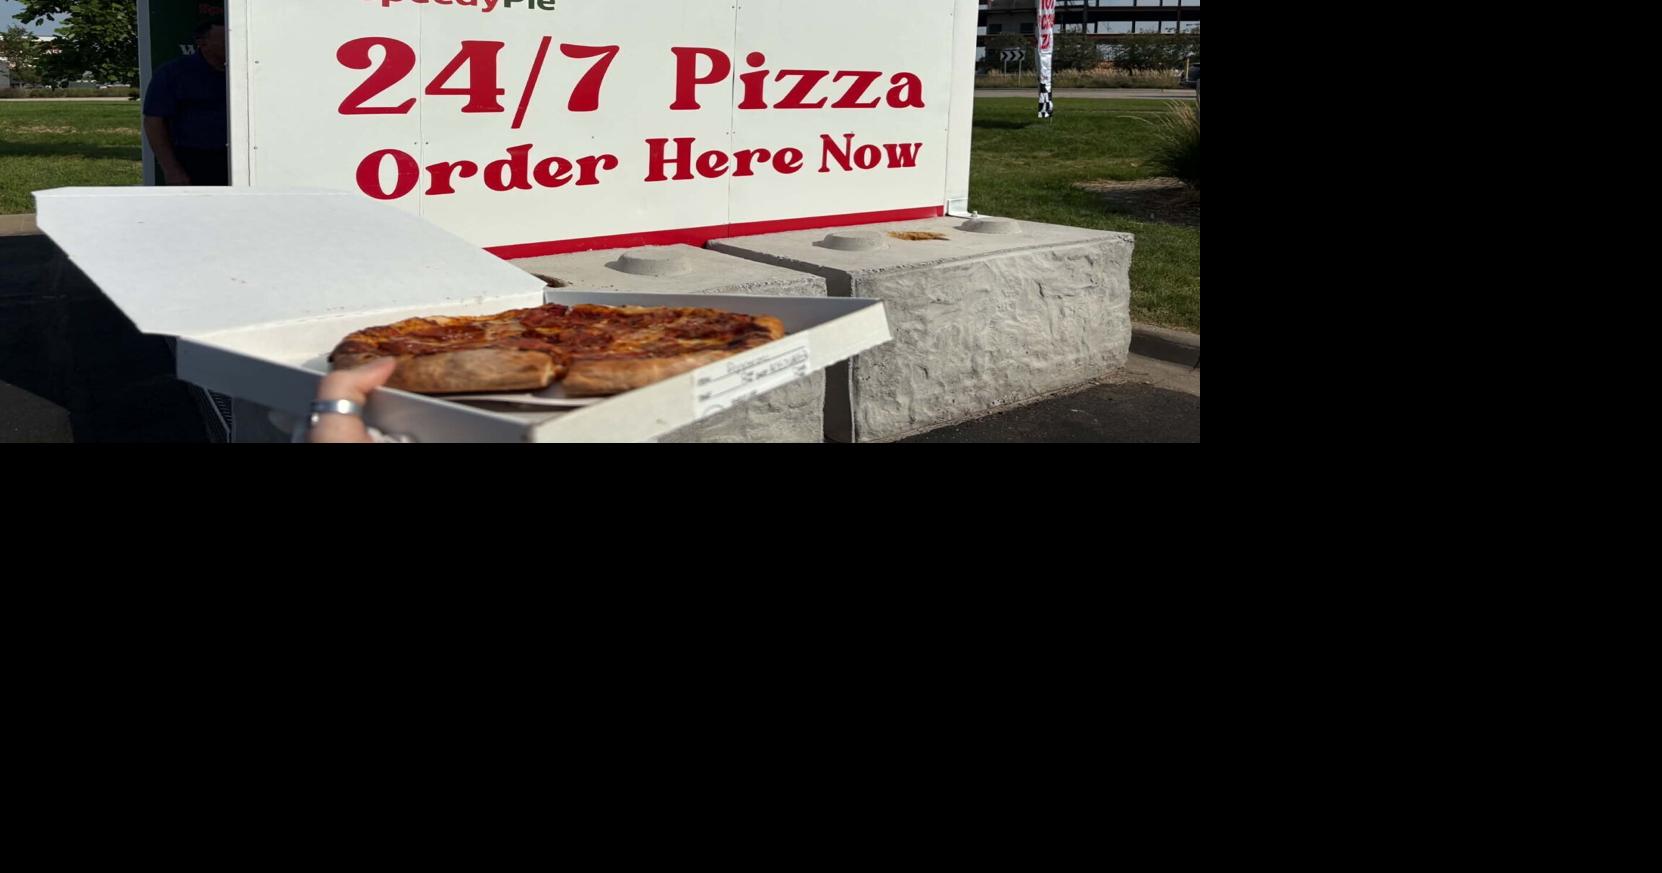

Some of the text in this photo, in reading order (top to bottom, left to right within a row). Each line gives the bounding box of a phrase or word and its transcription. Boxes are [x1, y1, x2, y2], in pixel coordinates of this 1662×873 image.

[336, 35, 925, 129] 24/7 Pizza
[355, 133, 922, 200] Order Here Now
